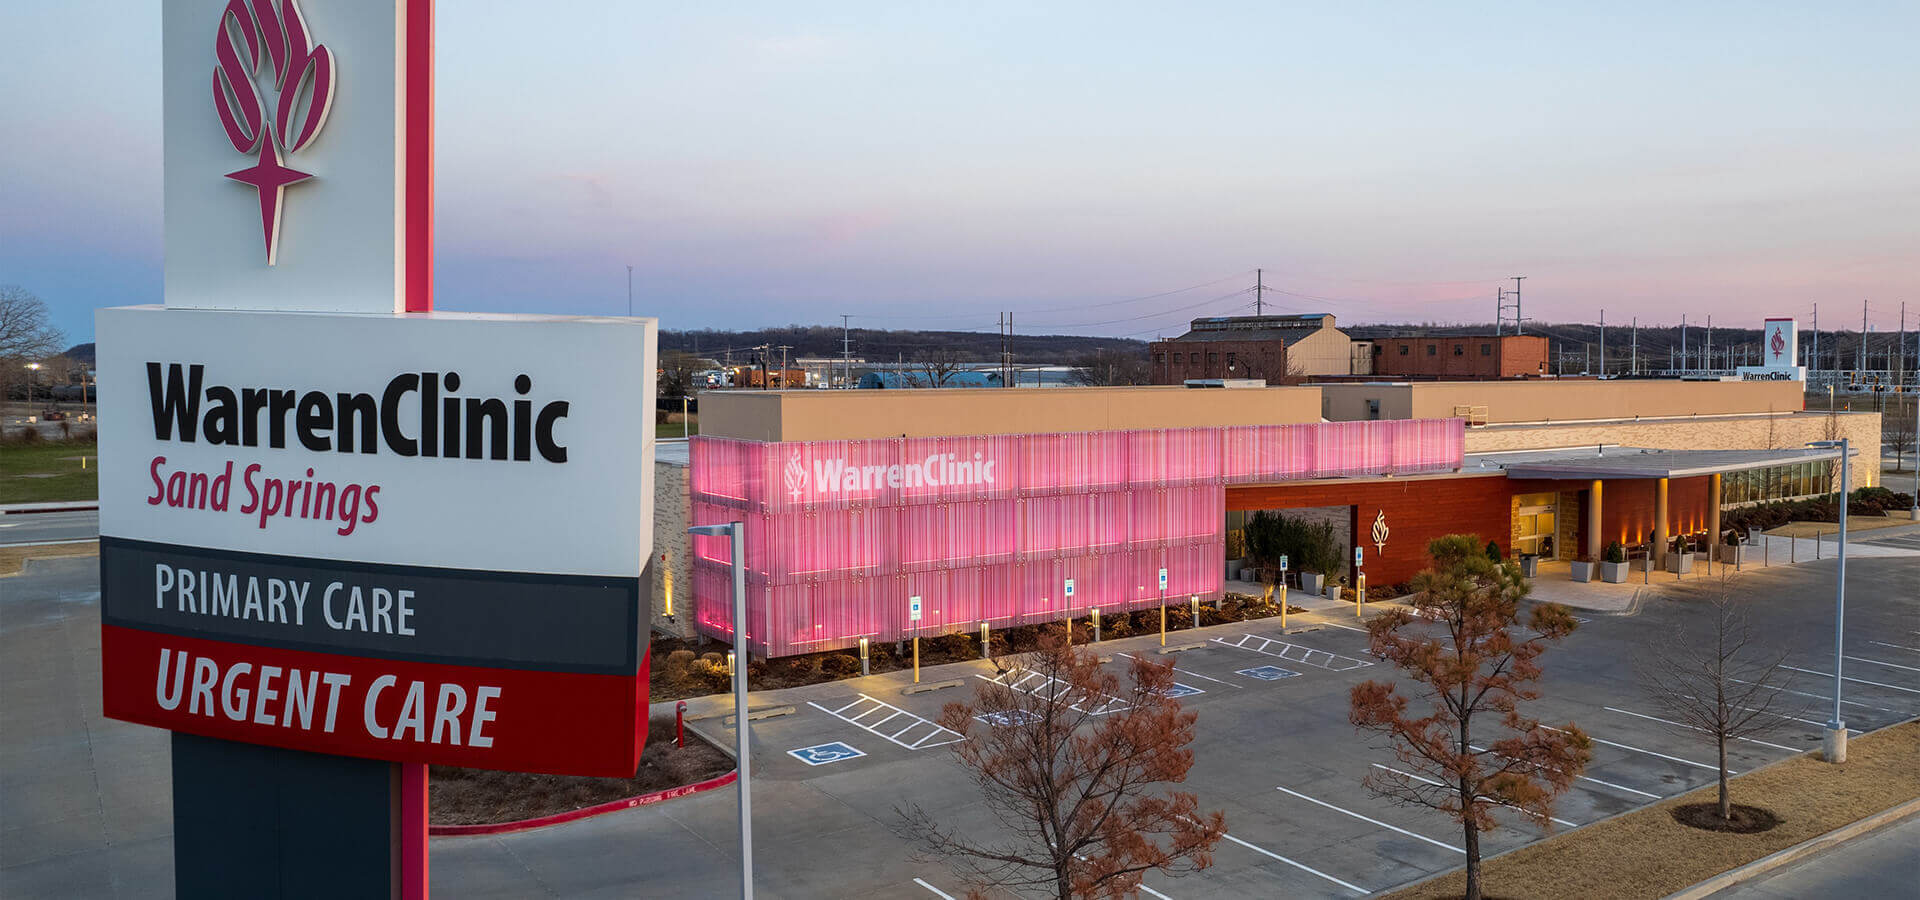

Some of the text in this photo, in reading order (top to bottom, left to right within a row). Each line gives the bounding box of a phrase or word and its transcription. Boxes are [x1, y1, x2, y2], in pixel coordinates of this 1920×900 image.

[146, 361, 570, 464] WarrenClinic
[1743, 371, 1792, 381] WarrenClinic
[147, 456, 380, 536] Sand Springs
[814, 452, 995, 493] WarrenClinic
[155, 563, 416, 637] PRIMARY CARE
[155, 648, 502, 749] URGENT CARE
